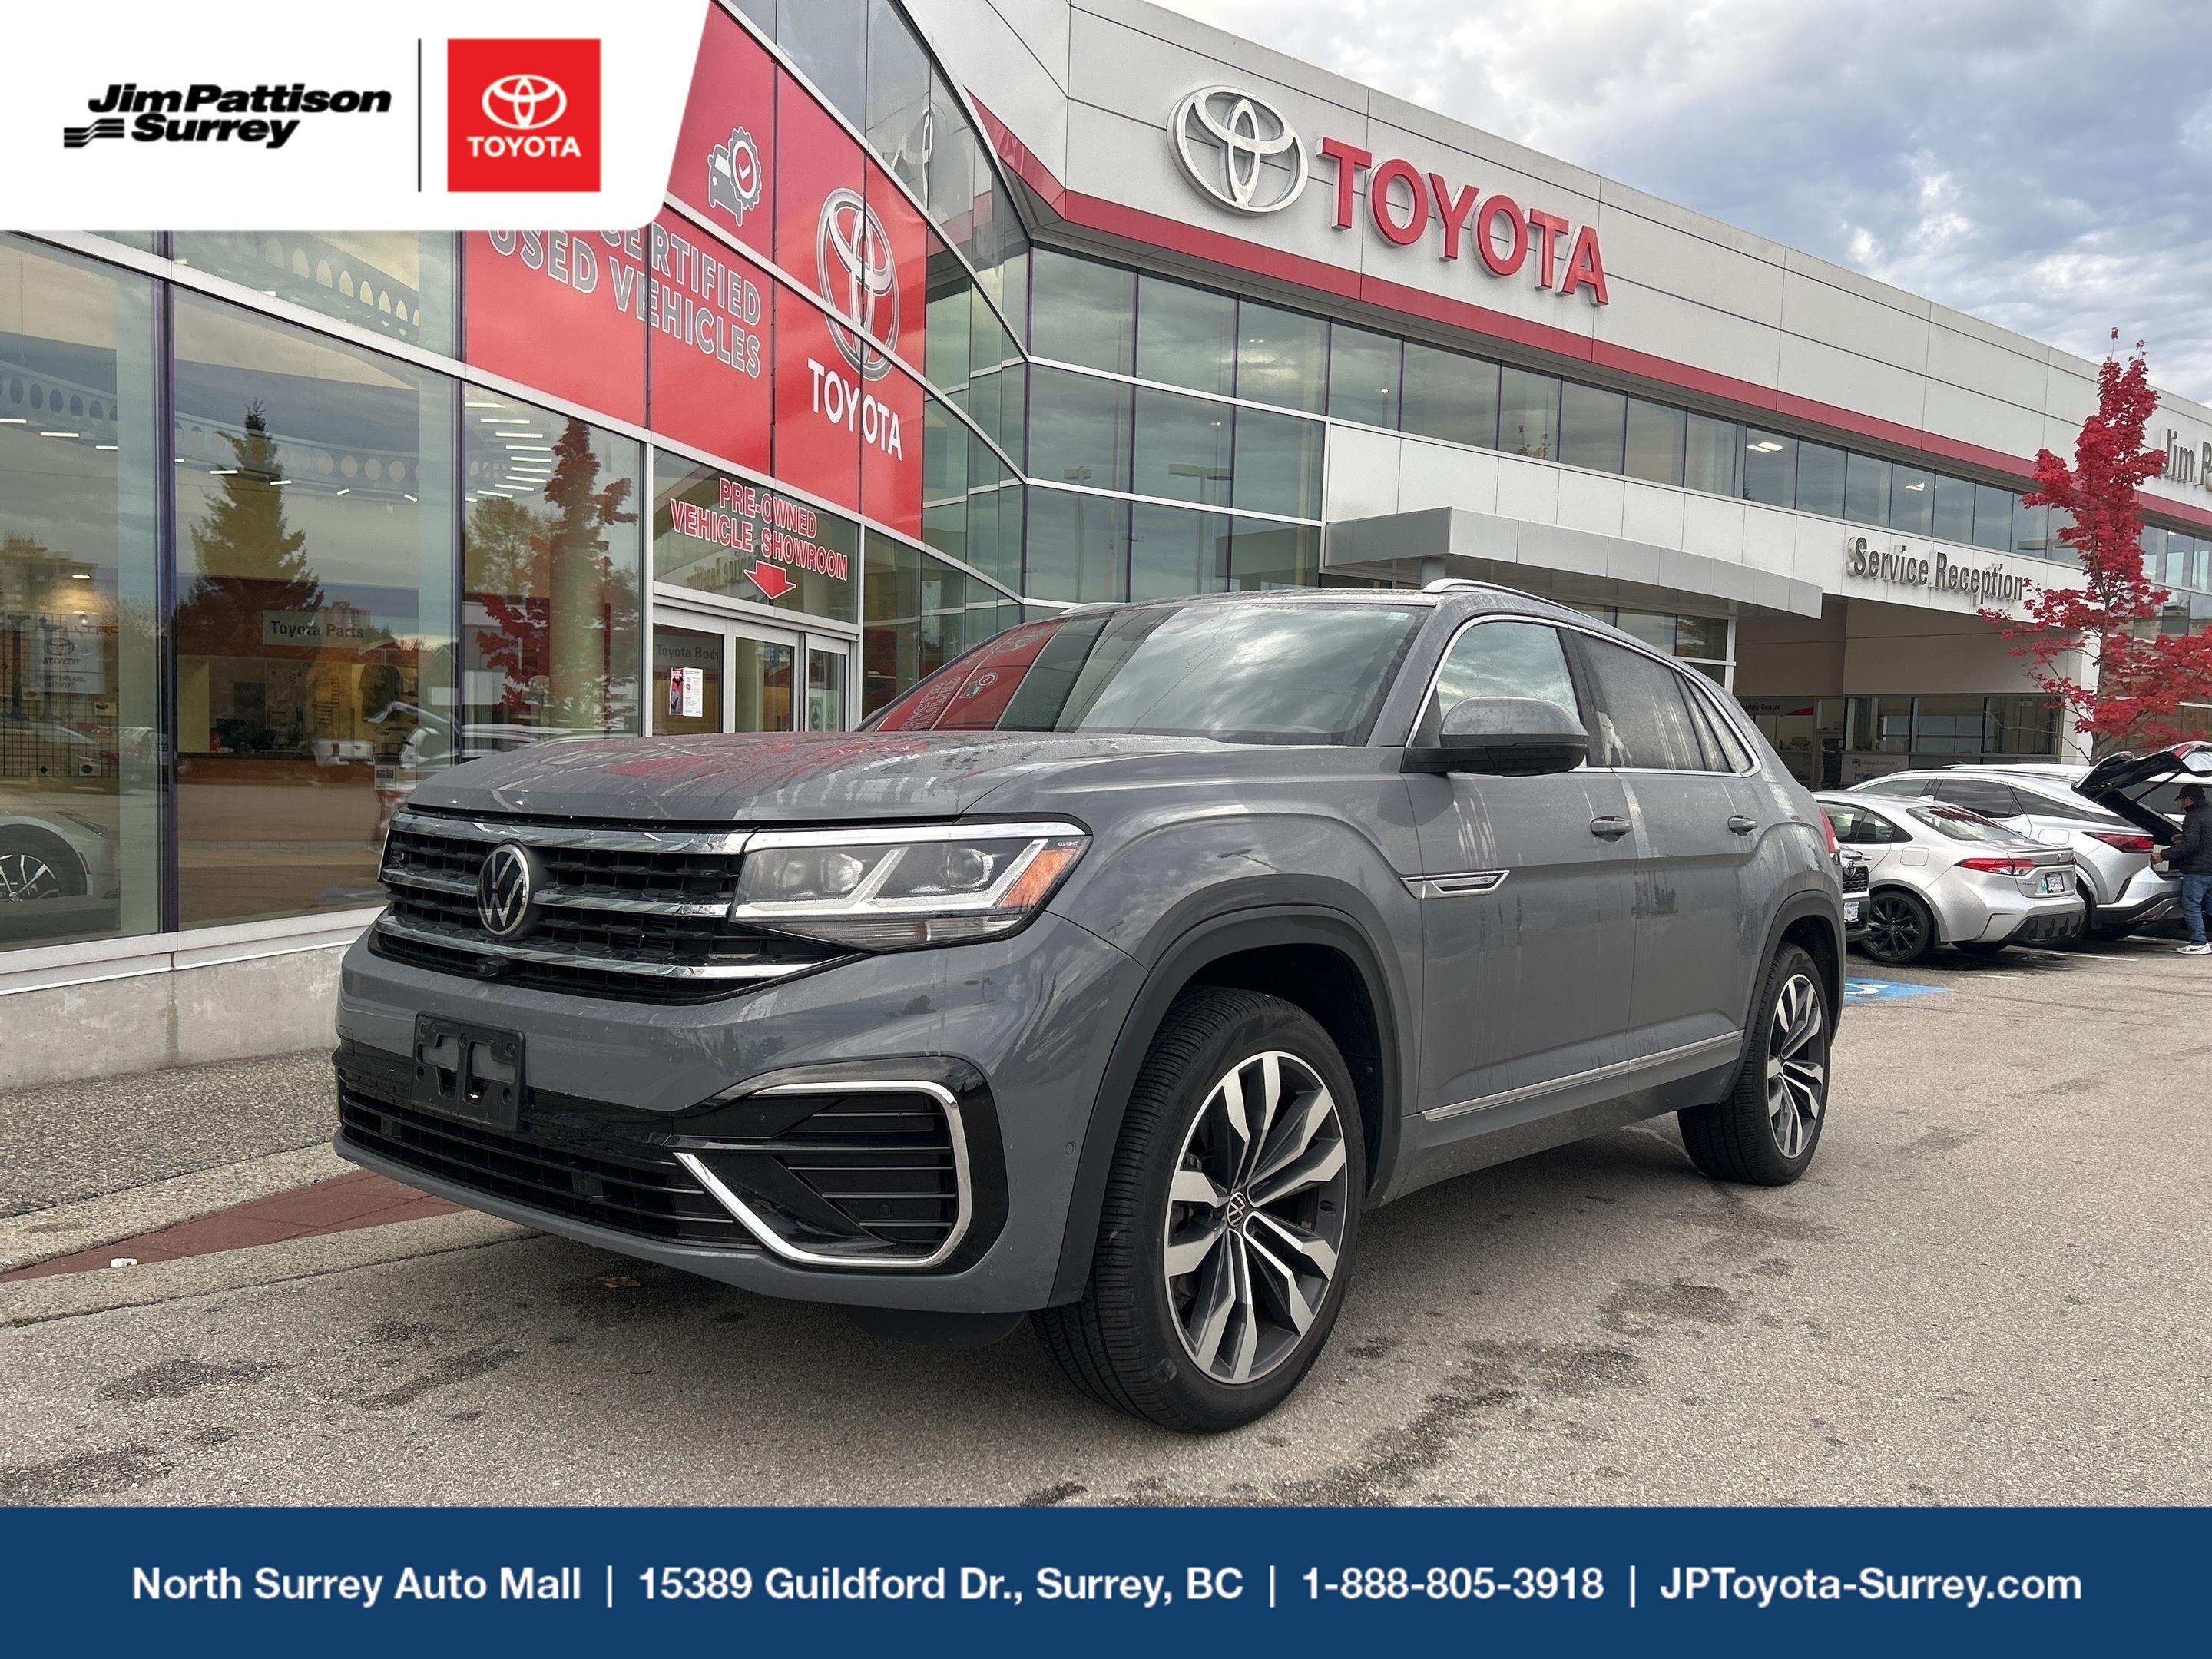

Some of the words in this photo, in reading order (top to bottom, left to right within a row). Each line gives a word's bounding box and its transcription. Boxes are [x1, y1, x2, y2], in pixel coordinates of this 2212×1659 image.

[1316, 136, 1609, 306] TOYOTA
[609, 256, 760, 379] VEHICLES
[807, 356, 902, 462] TOYOTA
[670, 498, 753, 553] VEHICLE
[760, 527, 848, 581] SHOWROOM
[719, 477, 817, 539] PRE-OWNED
[1847, 537, 1929, 586] Service
[1931, 551, 2023, 605] Reception
[270, 620, 320, 637] Toyota
[326, 623, 364, 639] Parts
[657, 644, 691, 660] Toyota
[1760, 703, 1781, 711] Centre
